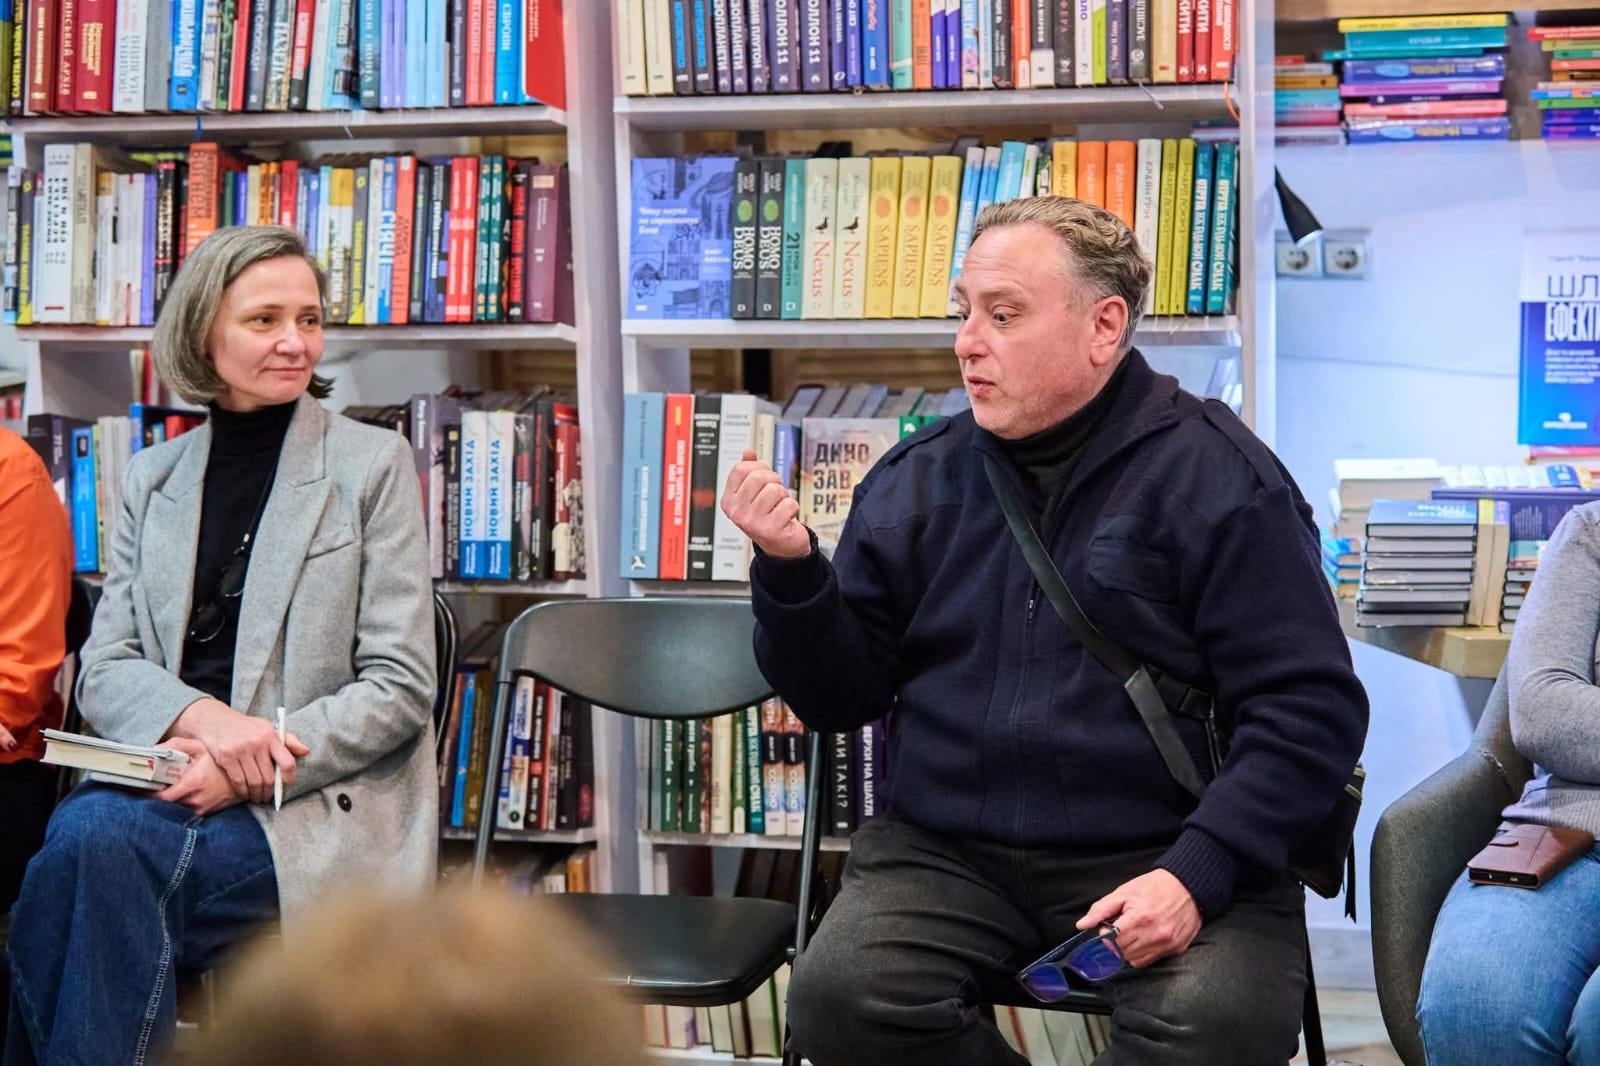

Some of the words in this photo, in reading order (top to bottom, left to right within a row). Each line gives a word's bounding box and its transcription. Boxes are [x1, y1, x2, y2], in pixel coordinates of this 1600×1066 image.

[751, 26, 762, 69] ПЛУТОН
[777, 49, 788, 64] 11
[809, 48, 820, 64] 11
[1144, 161, 1152, 195] БРАЯН
[733, 228, 744, 269] DEUS
[743, 227, 755, 270] HOMO
[759, 227, 770, 269] DEUS
[769, 226, 781, 270] HOMO
[786, 232, 801, 249] 21
[877, 225, 889, 288] SAPIENS
[905, 225, 920, 288] SAPIENS
[933, 223, 948, 288] SAPIENS
[813, 240, 830, 298] Nexus
[843, 240, 860, 298] Nexus
[1189, 261, 1203, 290] СМАК
[1211, 261, 1224, 291] СМАК
[1545, 302, 1600, 342] ЕФЕКТ
[464, 439, 475, 483] ЗАХІД
[489, 439, 500, 483] ЗАХІД
[813, 442, 870, 466] ДИНО
[813, 469, 851, 490] ЗАВ
[813, 494, 837, 514] РИ
[836, 733, 845, 758] МИ
[862, 726, 873, 761] ВЕРХИ
[769, 769, 777, 808] СОБОЮ
[790, 770, 798, 809] СОБОЮ
[837, 764, 848, 808] ТАКІ?
[863, 762, 873, 779] НА
[864, 781, 875, 816] ШАТЛІ
